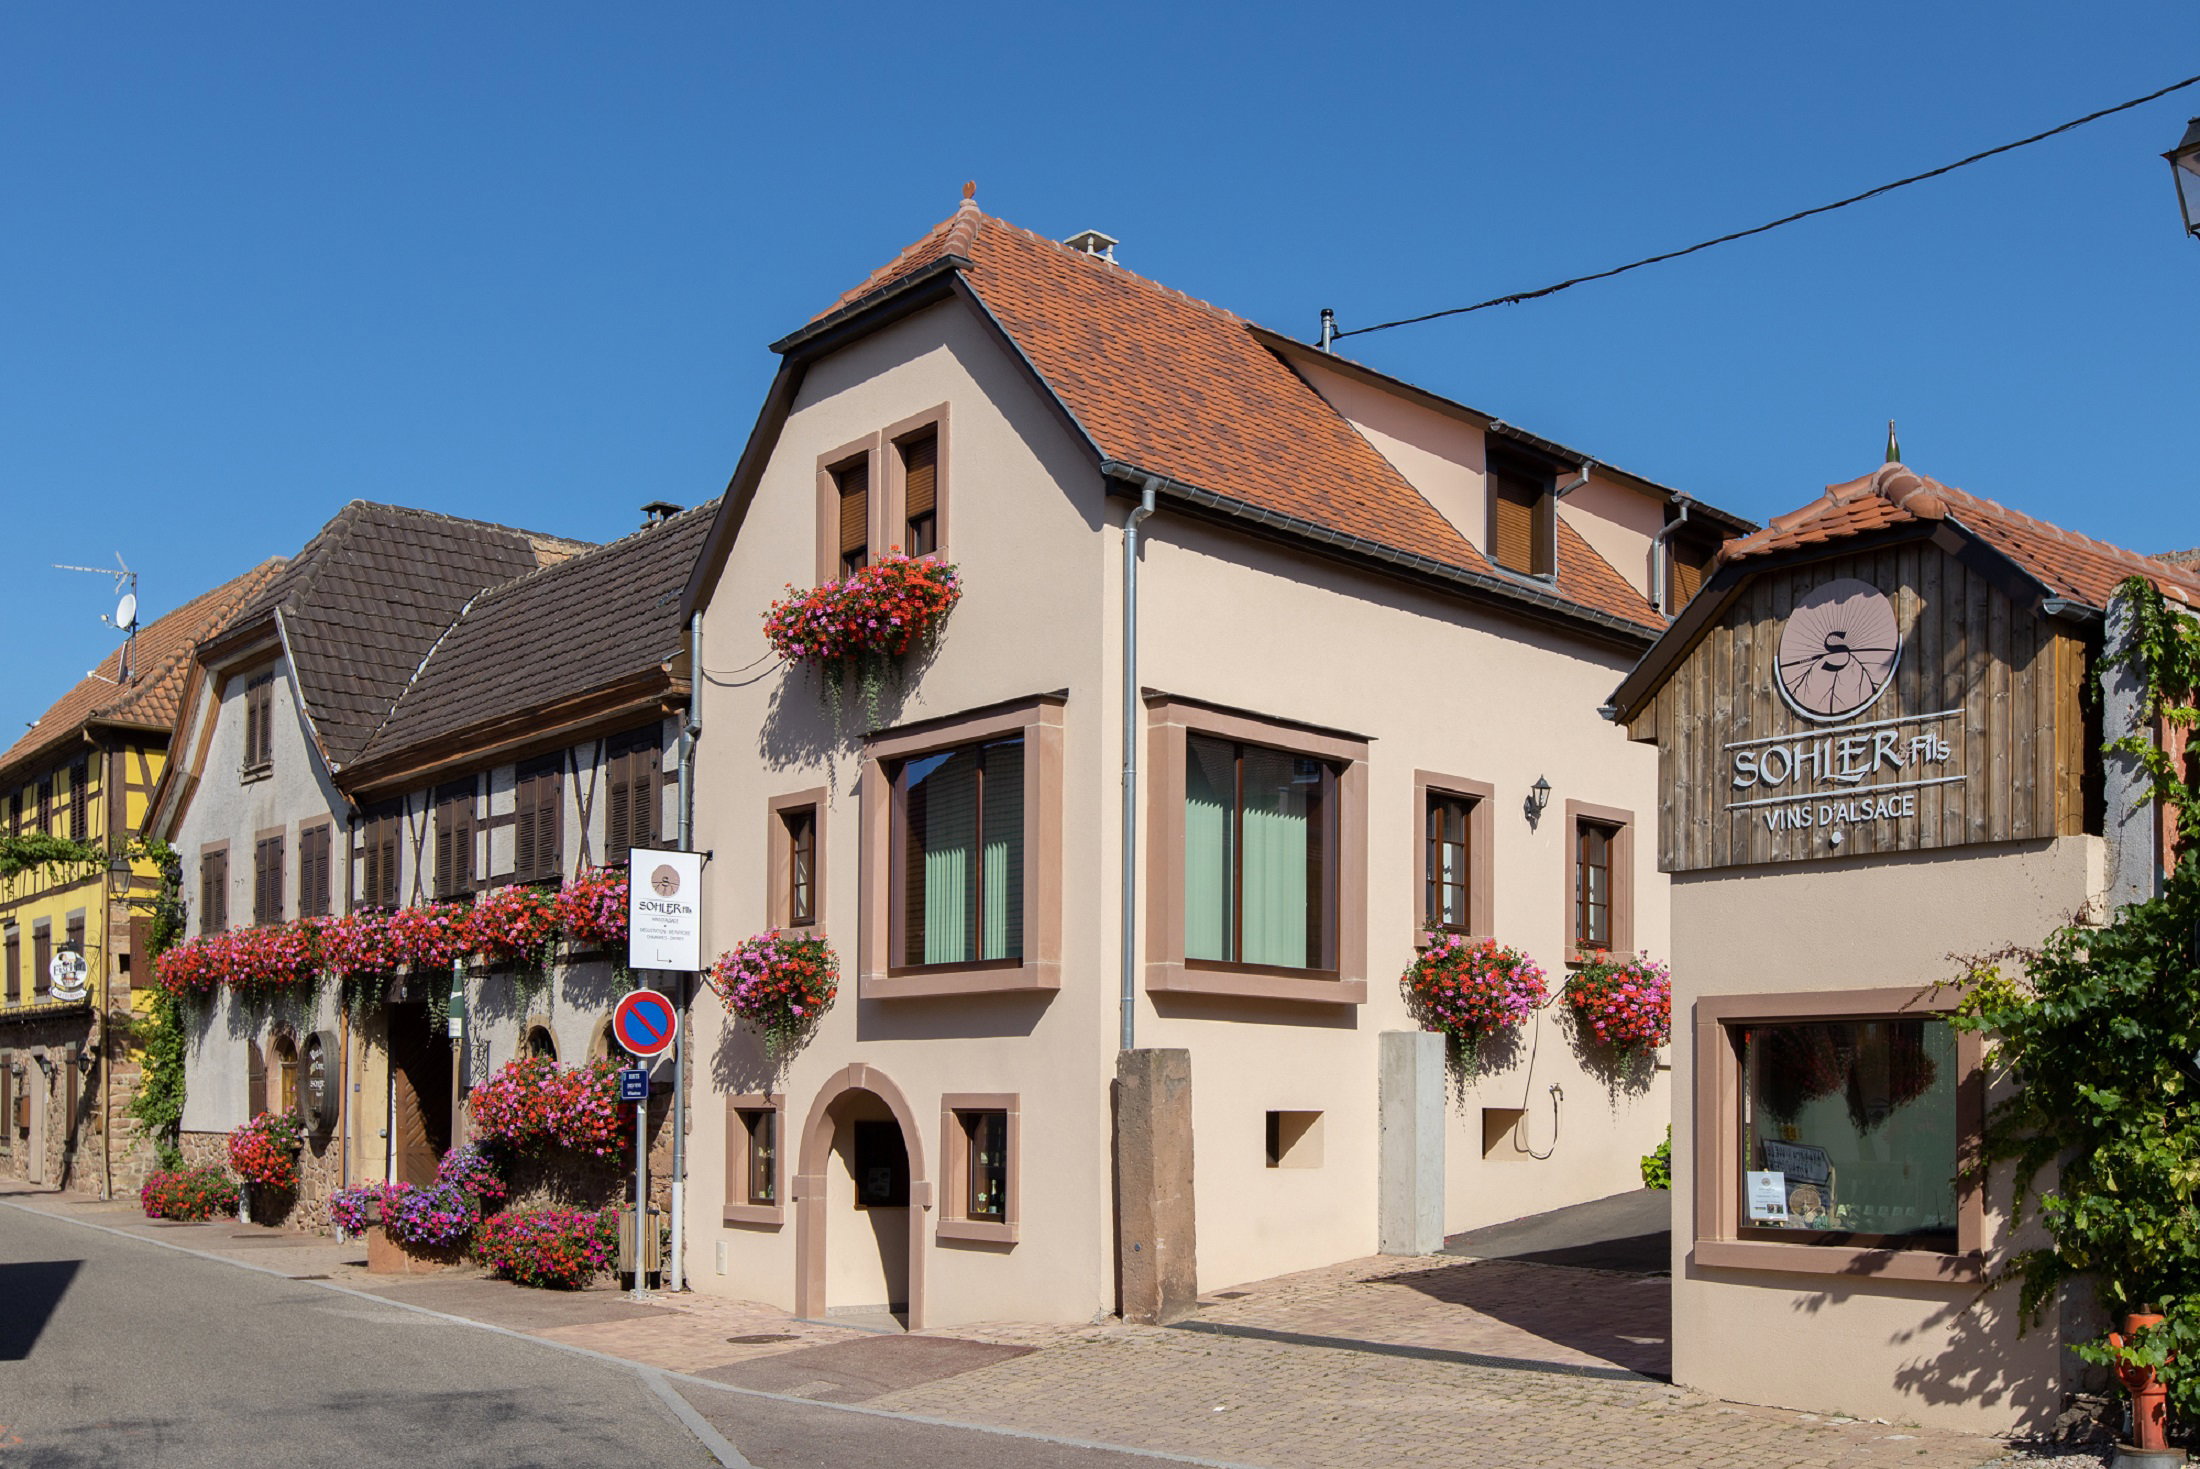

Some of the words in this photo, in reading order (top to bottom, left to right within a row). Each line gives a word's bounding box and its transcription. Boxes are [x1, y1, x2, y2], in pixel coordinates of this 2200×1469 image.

[1821, 631, 1850, 672] S
[1733, 730, 1905, 787] SOHLER
[1910, 732, 1951, 764] Fils
[1765, 805, 1813, 831] VINS
[1818, 795, 1914, 826] D'ALSACE
[639, 901, 681, 915] SOHLER
